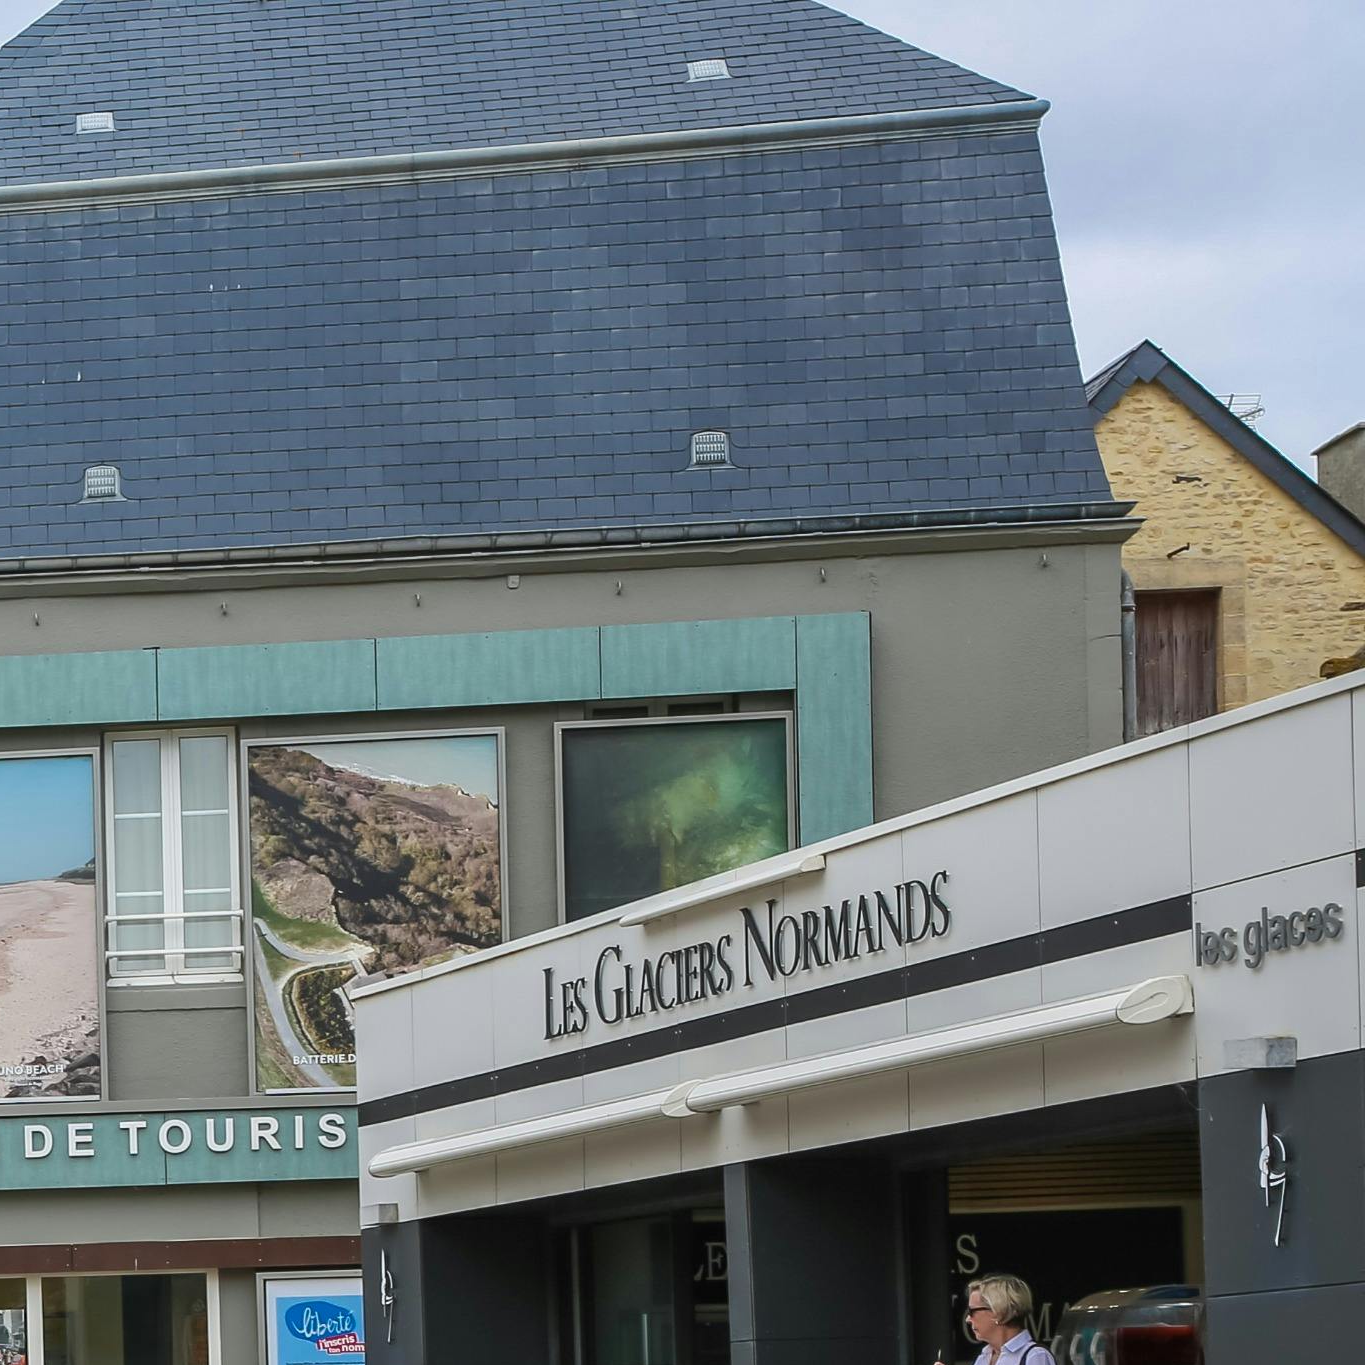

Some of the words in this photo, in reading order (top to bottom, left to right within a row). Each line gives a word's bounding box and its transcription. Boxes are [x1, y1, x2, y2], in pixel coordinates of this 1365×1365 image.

[1195, 922, 1236, 967] les
[1244, 901, 1344, 969] glaces
[542, 967, 586, 1041] LES
[594, 945, 733, 1026] GLACIERS
[740, 870, 951, 987] NORMANDS
[26, 1065, 64, 1074] BEACH
[293, 1055, 346, 1065] BATTERIE
[23, 1123, 95, 1160] DE
[119, 1113, 349, 1156] TOURIS
[292, 1307, 354, 1337] liberté
[341, 1343, 365, 1352] nom
